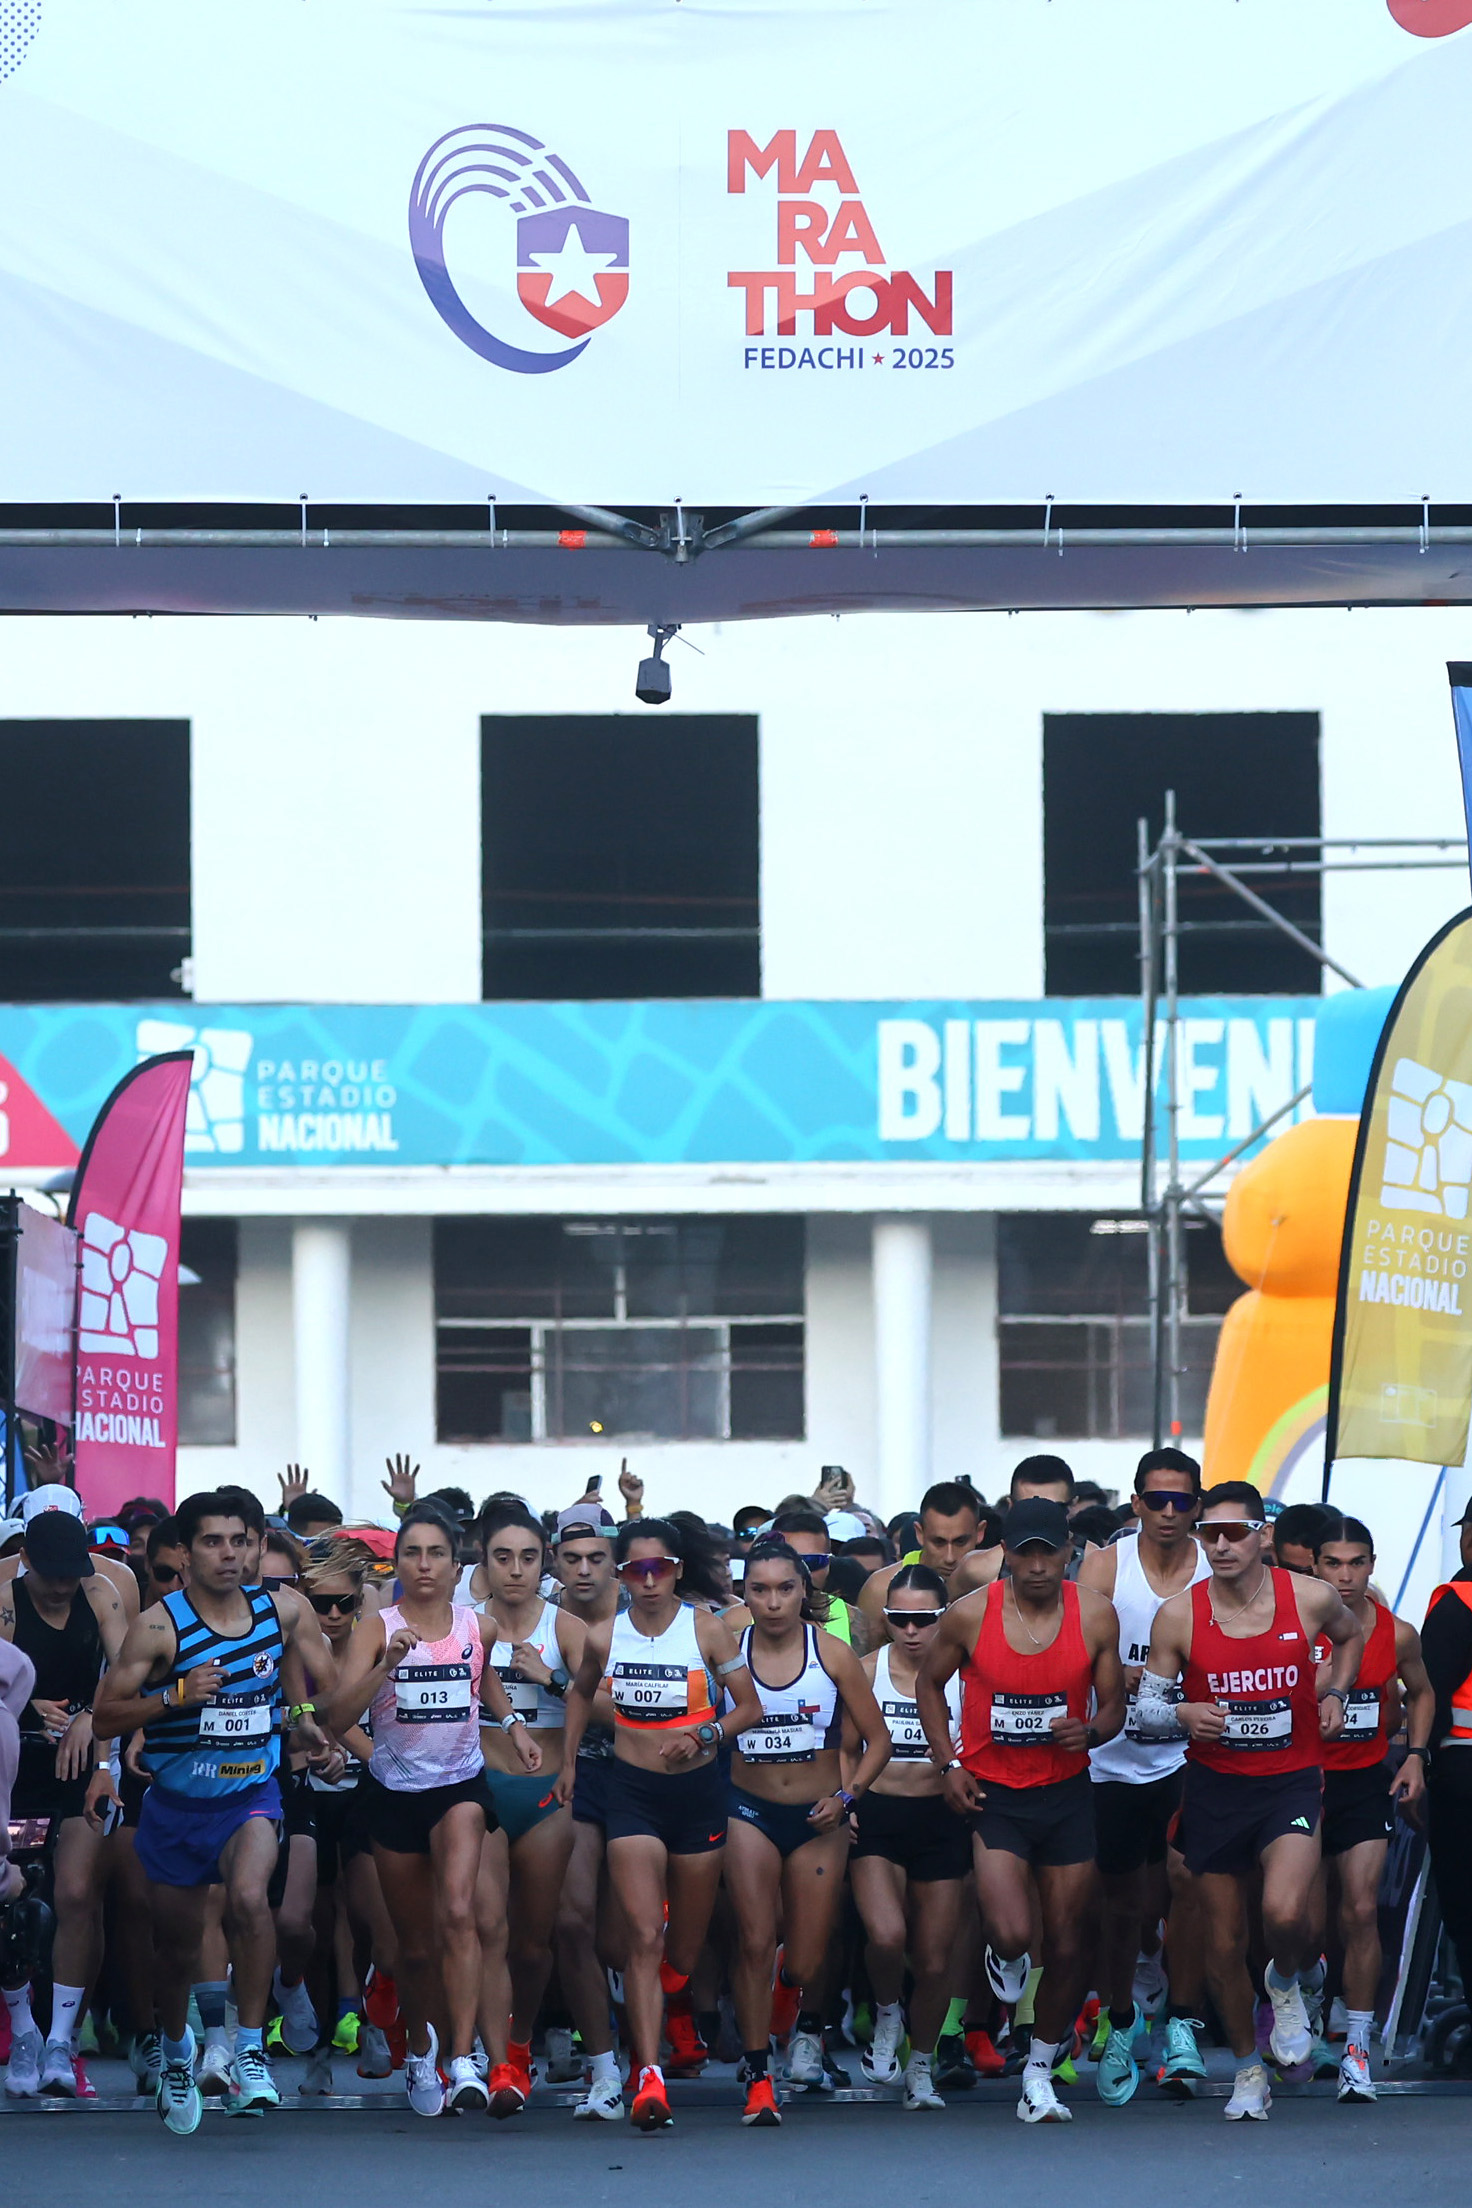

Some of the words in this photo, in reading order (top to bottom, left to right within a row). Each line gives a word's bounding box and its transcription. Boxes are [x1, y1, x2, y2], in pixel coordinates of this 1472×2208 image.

[727, 129, 860, 194] MA
[777, 200, 886, 265] RA
[727, 270, 953, 336] THON
[743, 347, 865, 370] FEDACHI
[891, 347, 955, 370] 2025
[257, 1059, 388, 1087] PARQUE
[257, 1084, 397, 1109] ESTADIO
[258, 1112, 399, 1151] NACIONAL
[1367, 1219, 1470, 1255] PARQUE
[1363, 1245, 1467, 1278] ESTADIO
[1359, 1269, 1462, 1315] NACIONAL
[81, 1388, 163, 1414] STADIO
[1207, 1664, 1298, 1693] EJERCITO
[420, 1691, 448, 1704] 013
[614, 1691, 624, 1701] W
[634, 1689, 662, 1703] 007
[203, 1721, 215, 1731] M
[225, 1718, 250, 1732] 001
[904, 1728, 922, 1741] 04
[994, 1718, 1005, 1728] M
[1015, 1717, 1043, 1729] 002
[1240, 1723, 1269, 1735] 026
[747, 1739, 756, 1749] W
[765, 1736, 791, 1749] 034
